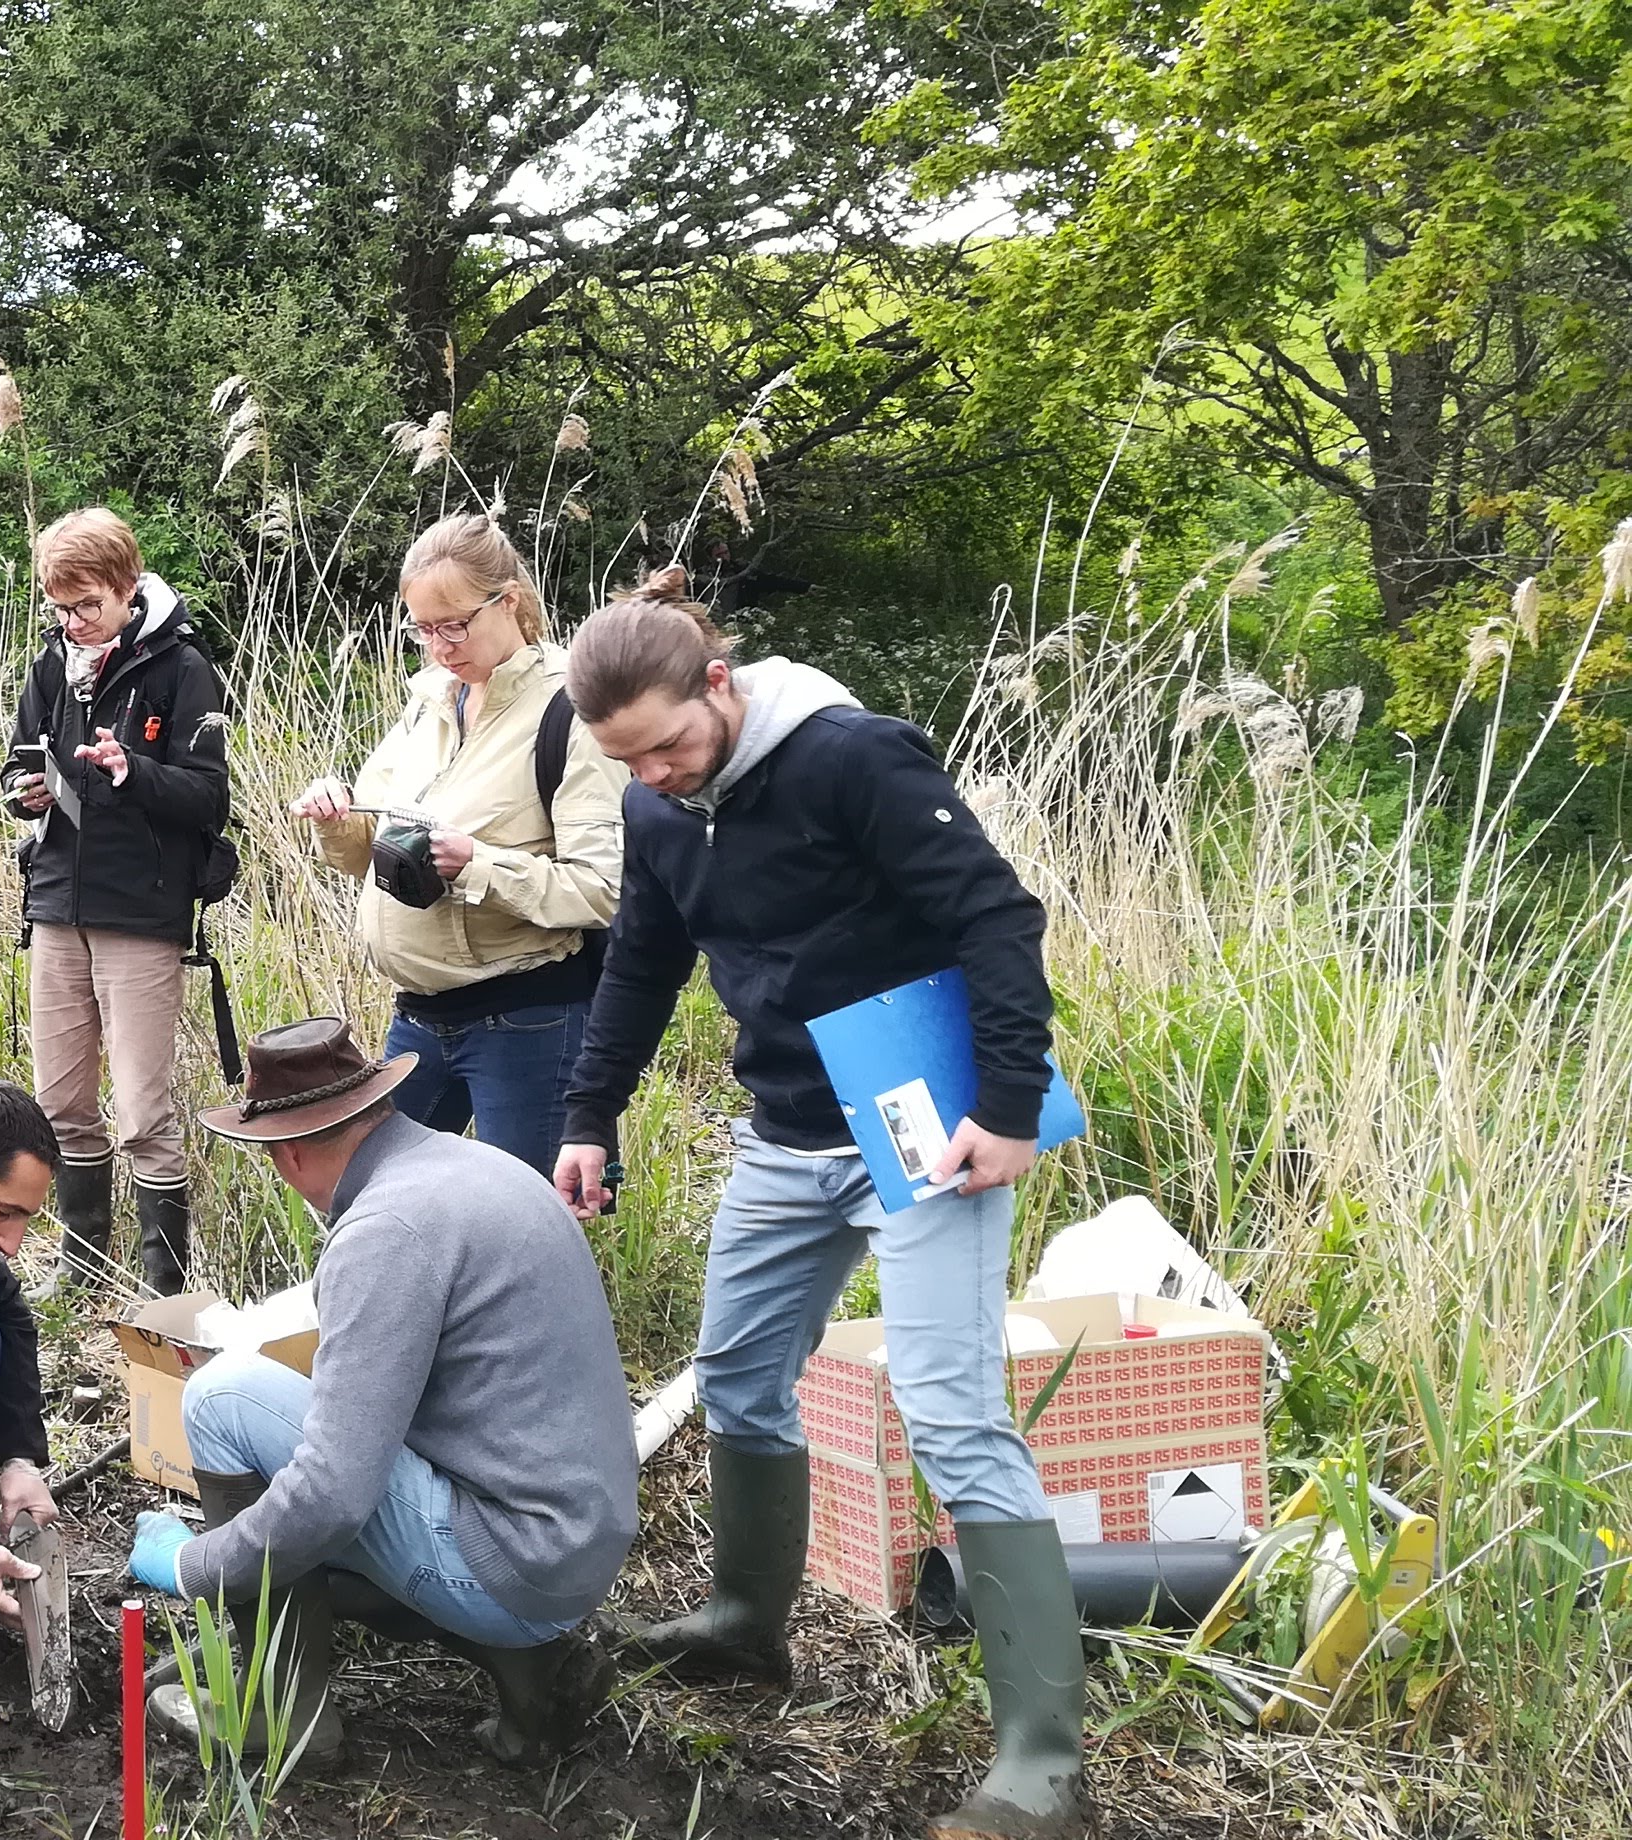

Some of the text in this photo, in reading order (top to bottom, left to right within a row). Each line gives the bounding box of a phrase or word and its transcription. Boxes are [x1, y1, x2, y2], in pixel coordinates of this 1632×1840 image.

[1019, 1359, 1033, 1372] RS
[1038, 1357, 1053, 1370] RS
[1077, 1353, 1091, 1366] RS
[1096, 1351, 1110, 1364] RS
[1115, 1349, 1129, 1362] RS
[1134, 1347, 1148, 1361] RS
[1152, 1345, 1167, 1359] RS
[1171, 1344, 1185, 1357] RS
[1189, 1342, 1204, 1355] RS
[1208, 1340, 1222, 1353] RS
[1226, 1338, 1240, 1351] RS
[1020, 1378, 1034, 1391] RS
[1078, 1372, 1092, 1385] RS
[1097, 1370, 1111, 1383] RS
[1115, 1368, 1130, 1381] RS
[1134, 1366, 1149, 1379] RS
[1153, 1364, 1167, 1377] RS
[1171, 1362, 1186, 1375] RS
[1190, 1360, 1204, 1374] RS
[1208, 1358, 1223, 1372] RS
[1226, 1357, 1241, 1370] RS
[1059, 1393, 1074, 1406] RS
[1078, 1391, 1093, 1404] RS
[1097, 1389, 1112, 1402] RS
[1116, 1387, 1130, 1400] RS
[1135, 1385, 1149, 1398] RS
[1153, 1383, 1168, 1396] RS
[1172, 1381, 1186, 1394] RS
[1190, 1379, 1205, 1392] RS
[1208, 1377, 1223, 1390] RS
[1227, 1375, 1241, 1388] RS
[885, 1391, 1259, 1442] RS RS RS RS RS RS RS RS RS RS RS RS RS
[886, 1448, 902, 1462] RS
[1042, 1433, 1056, 1446] RS
[1061, 1430, 1075, 1444] RS
[1080, 1428, 1094, 1441] RS
[1099, 1426, 1113, 1439] RS
[1117, 1424, 1132, 1437] RS
[1136, 1422, 1150, 1435] RS
[1154, 1420, 1169, 1433] RS
[1173, 1418, 1187, 1431] RS
[1191, 1416, 1205, 1429] RS
[1209, 1414, 1223, 1427] RS
[1227, 1411, 1241, 1425] RS
[1245, 1409, 1259, 1423] RS
[887, 1439, 1259, 1491] RS RS RS RS RS RS RS RS RS RS RS RS RS
[888, 1496, 905, 1510] RS
[1062, 1479, 1077, 1493] RS
[1081, 1477, 1096, 1490] RS
[1100, 1475, 1114, 1488] RS
[1119, 1473, 1133, 1486] RS
[1101, 1494, 1115, 1507] RS
[1119, 1491, 1134, 1505] RS
[1247, 1476, 1261, 1489] RS
[1101, 1513, 1116, 1526] RS
[1120, 1510, 1135, 1524] RS
[1248, 1495, 1262, 1508] RS
